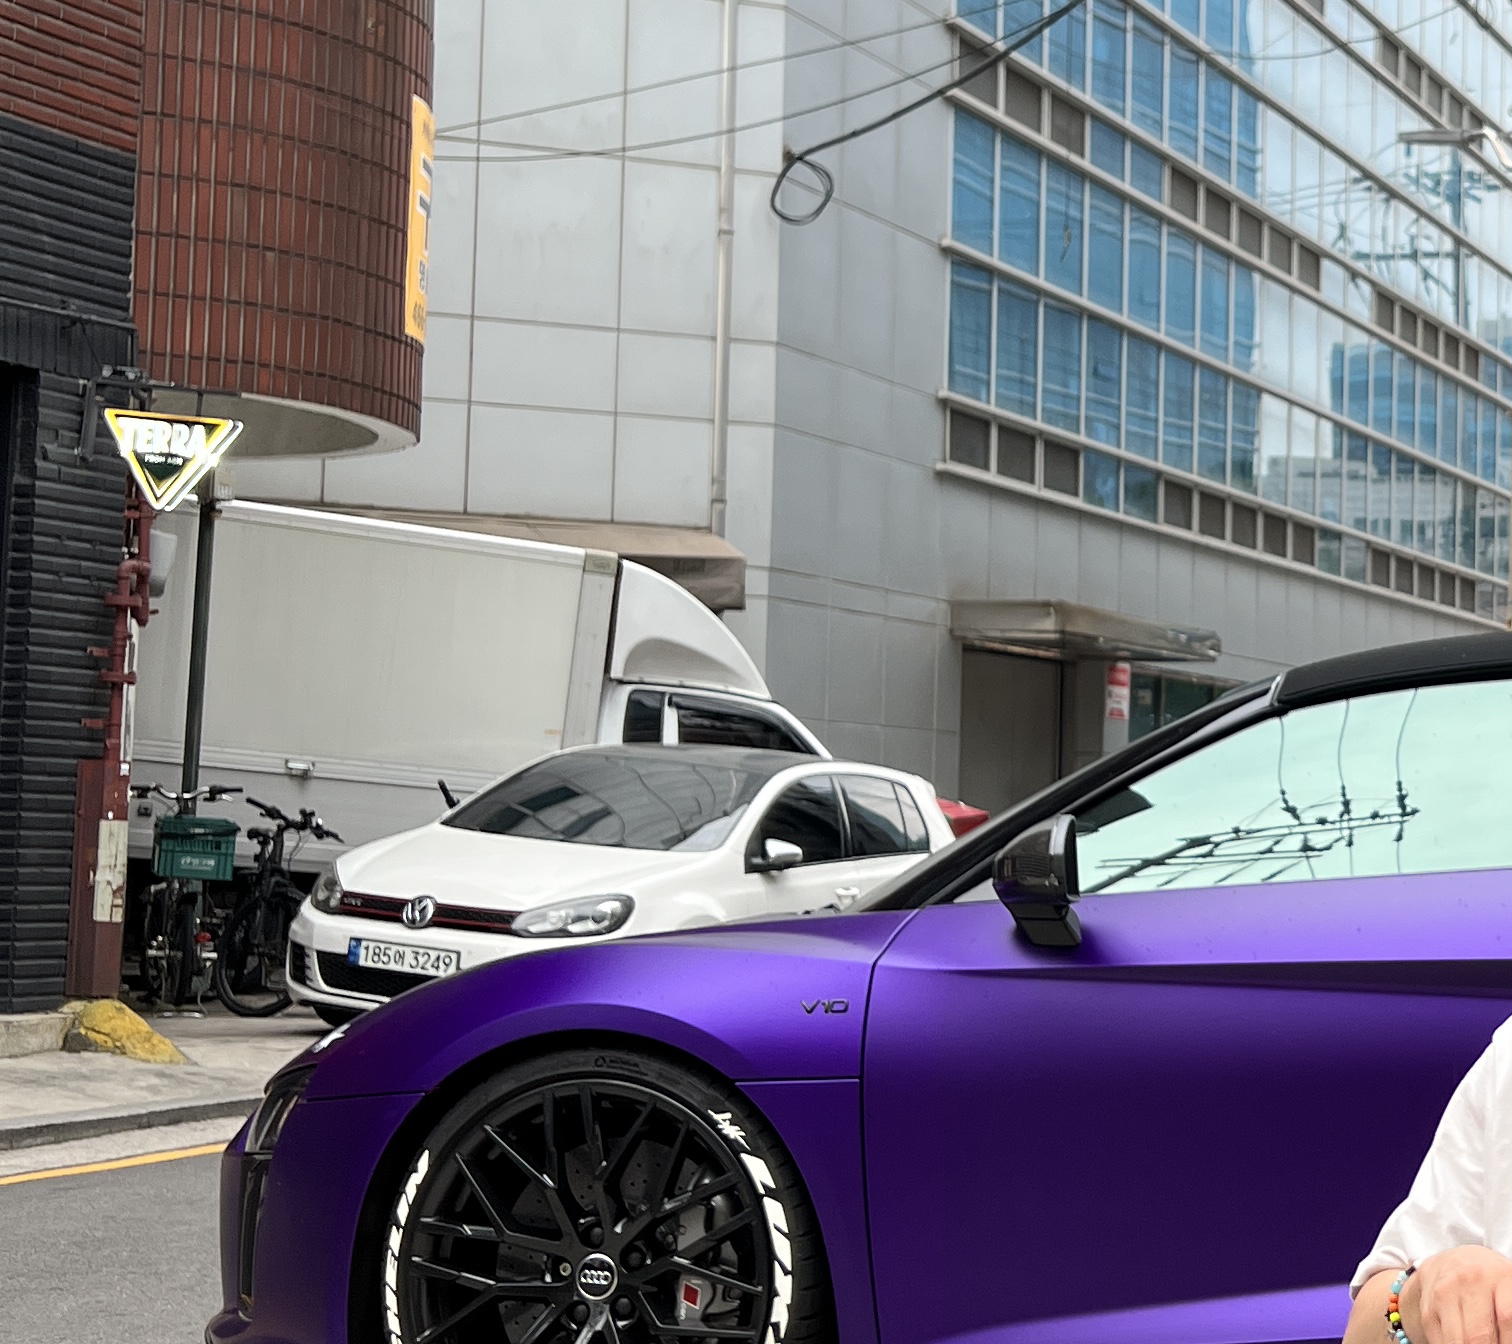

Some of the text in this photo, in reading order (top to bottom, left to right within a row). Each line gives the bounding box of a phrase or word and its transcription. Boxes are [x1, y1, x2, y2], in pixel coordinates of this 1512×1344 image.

[118, 417, 208, 459] TERRA
[408, 950, 453, 974] 3249
[800, 998, 850, 1015] V10
